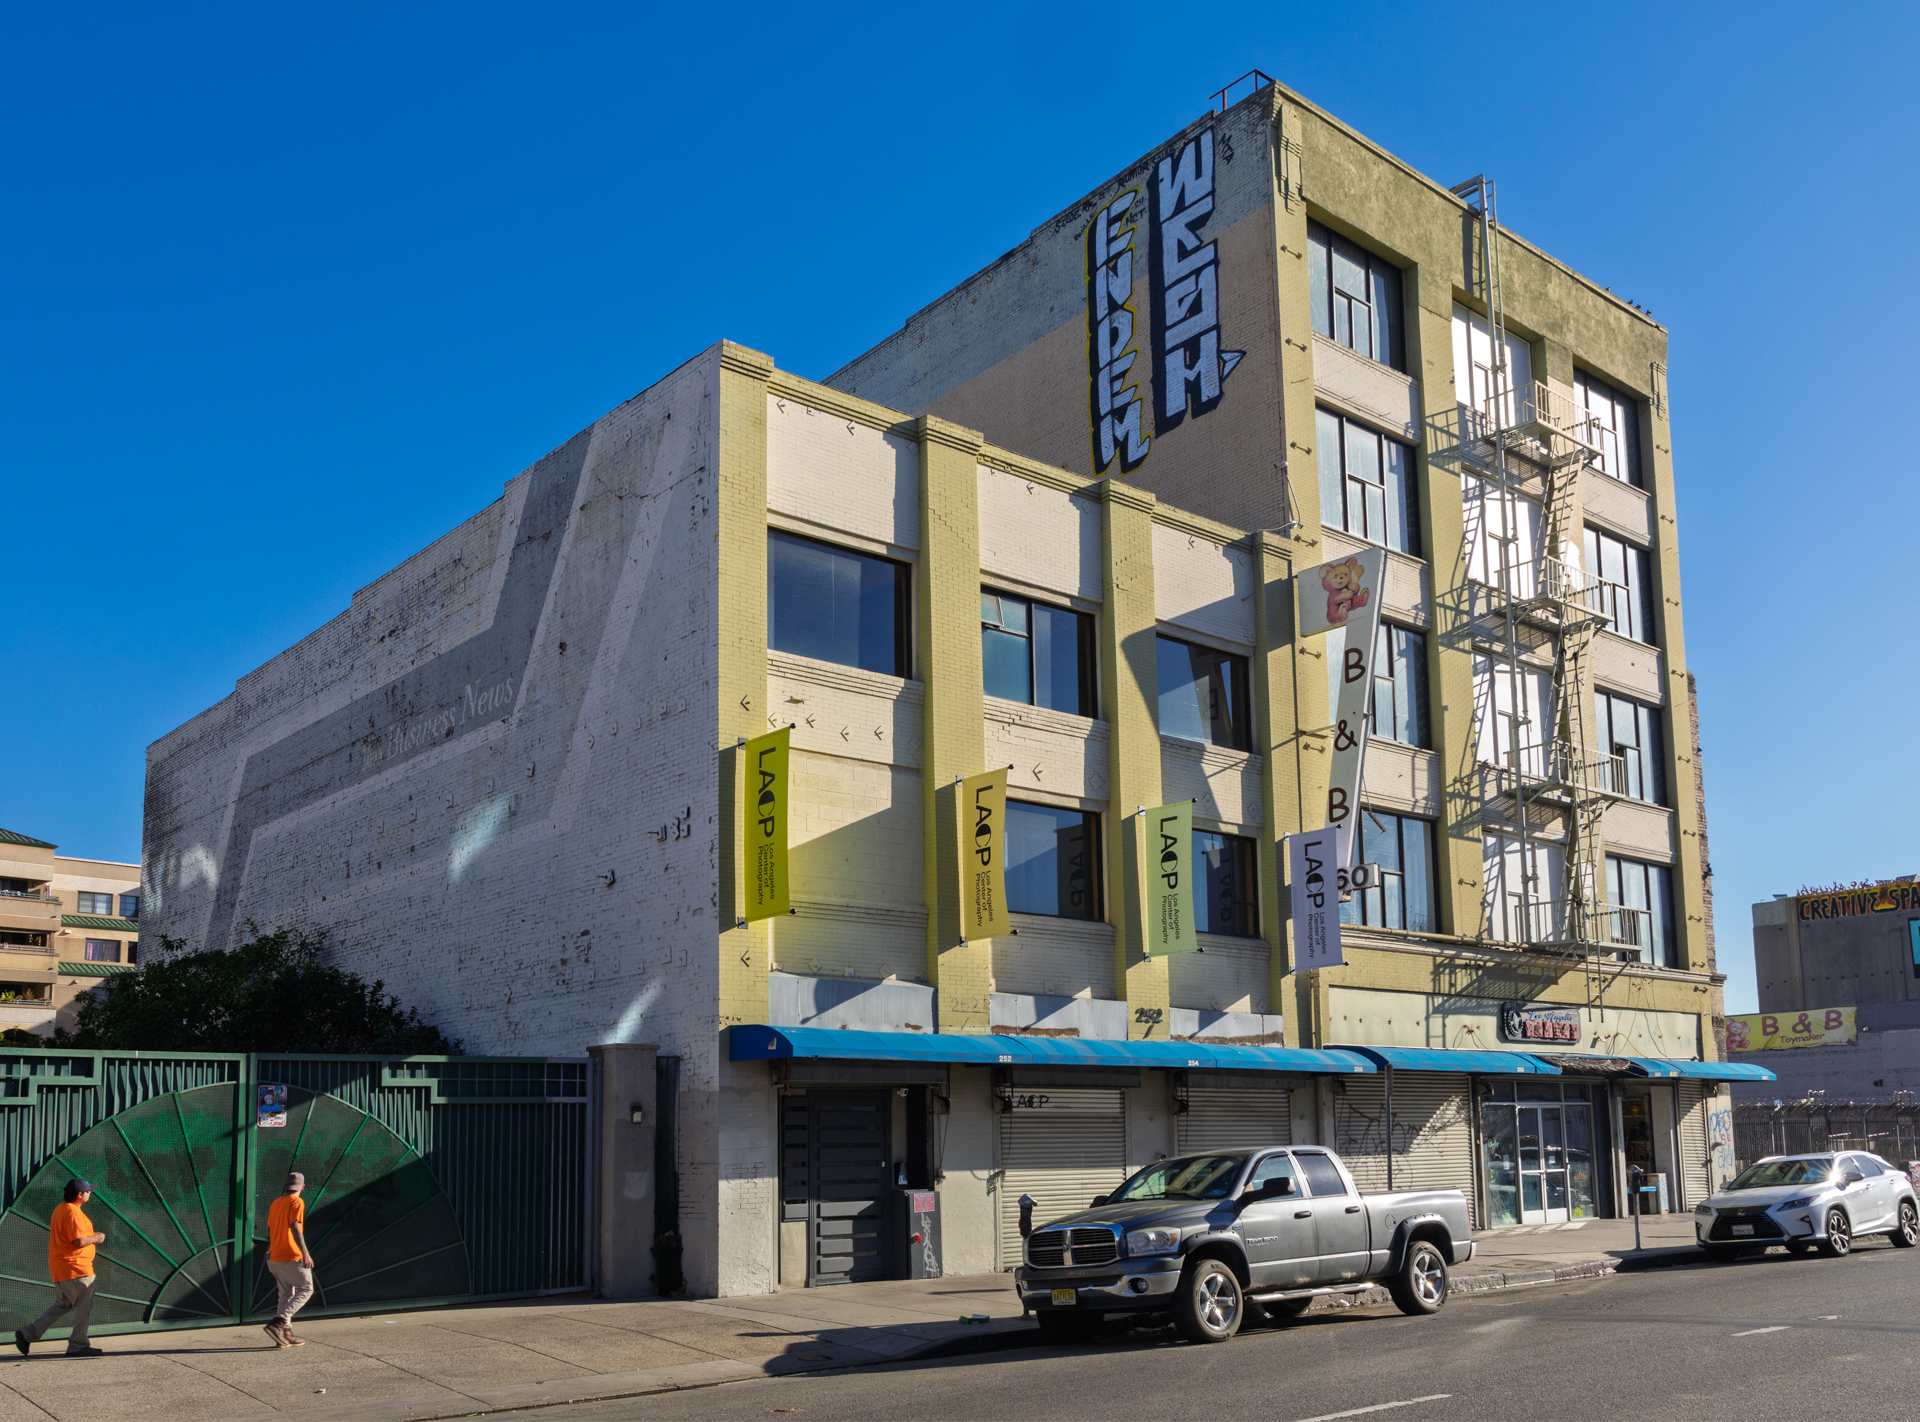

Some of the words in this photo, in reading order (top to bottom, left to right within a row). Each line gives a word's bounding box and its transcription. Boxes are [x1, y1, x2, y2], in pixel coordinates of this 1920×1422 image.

[1344, 647, 1366, 684] B
[460, 678, 513, 725] News
[1334, 719, 1358, 752] &
[757, 747, 777, 838] LACP
[1328, 787, 1350, 823] B
[974, 785, 993, 867] LACP
[1160, 816, 1178, 890] LACP
[1304, 841, 1325, 909] LACP
[1800, 891, 1880, 921] CREATIVE
[1135, 1007, 1163, 1024] 252
[1761, 1015, 1780, 1037] B
[1791, 1013, 1812, 1034] &
[1824, 1009, 1844, 1031] B
[1779, 1032, 1825, 1045] Toymaker
[999, 1055, 1012, 1063] 252
